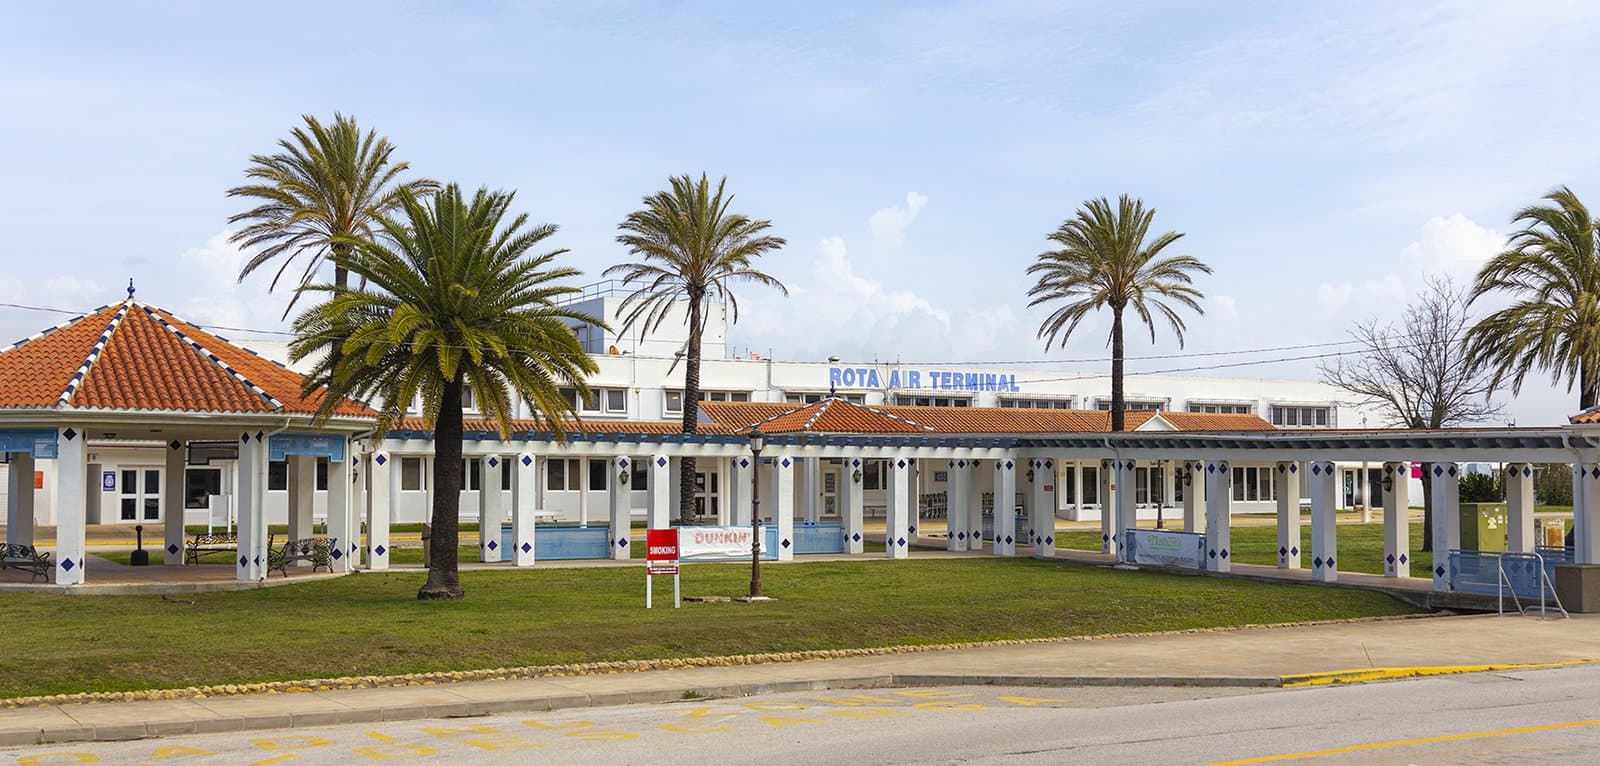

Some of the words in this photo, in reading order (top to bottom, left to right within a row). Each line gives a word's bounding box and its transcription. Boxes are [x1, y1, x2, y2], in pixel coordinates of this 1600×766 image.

[829, 367, 880, 388] ROTA
[889, 370, 922, 390] AIR
[929, 371, 1020, 393] TERMINAL
[649, 546, 676, 555] SMOKING
